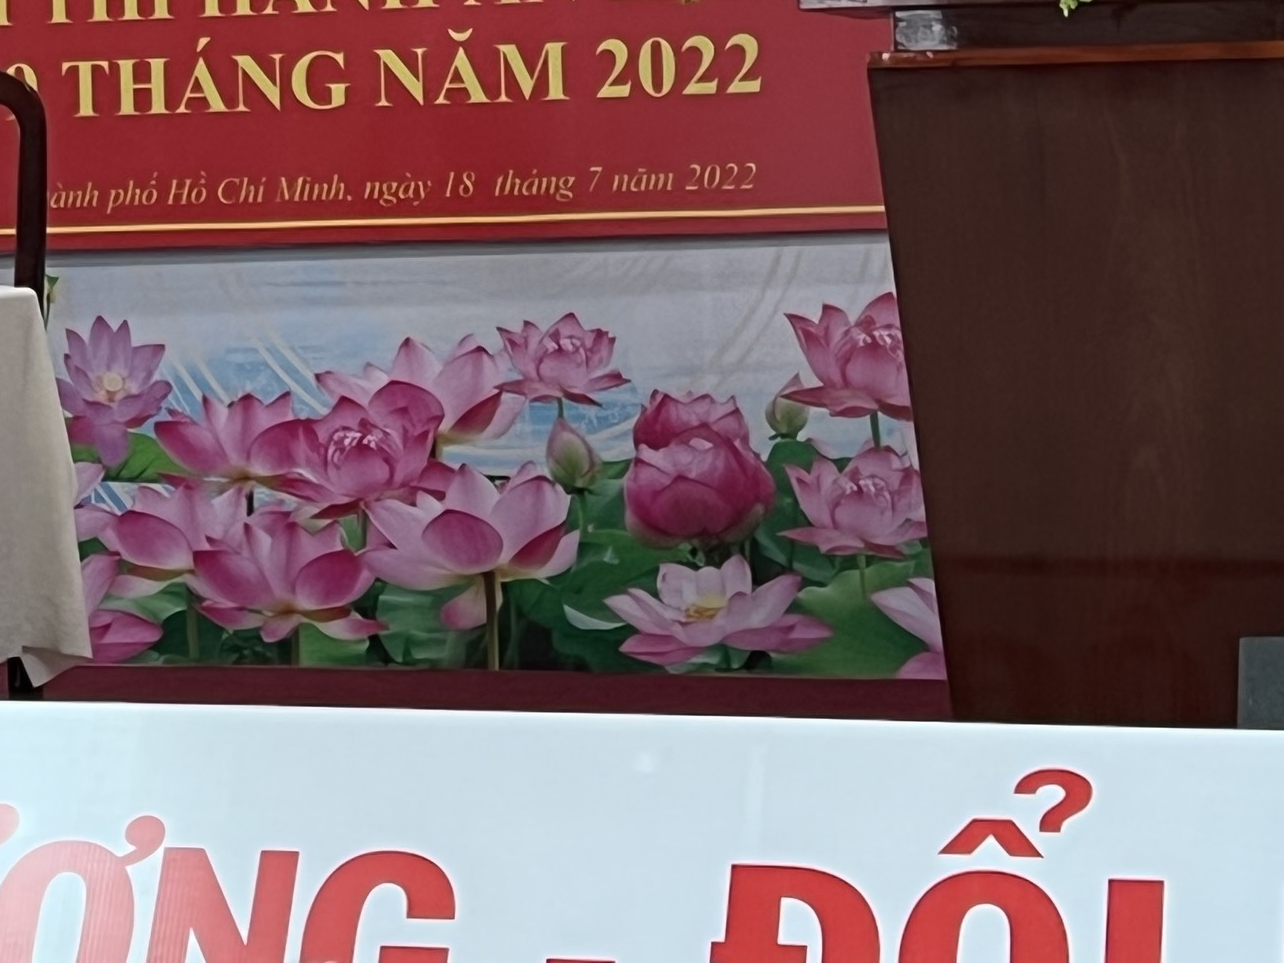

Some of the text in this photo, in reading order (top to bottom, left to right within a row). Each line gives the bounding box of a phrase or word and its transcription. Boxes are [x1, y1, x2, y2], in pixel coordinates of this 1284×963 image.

[61, 37, 351, 118] THÁNG
[373, 27, 571, 107] NĂM
[595, 33, 762, 98] 2022
[49, 181, 100, 209] ành
[106, 171, 159, 214] phố
[167, 170, 208, 205] Hồ
[217, 175, 267, 205] Chí
[364, 171, 432, 207] ngày
[445, 170, 476, 197] 18
[494, 168, 576, 202] tháng
[588, 166, 603, 193] 7
[613, 167, 674, 193] năm
[685, 162, 758, 191] 2022
[709, 768, 1165, 963] ĐỔI
